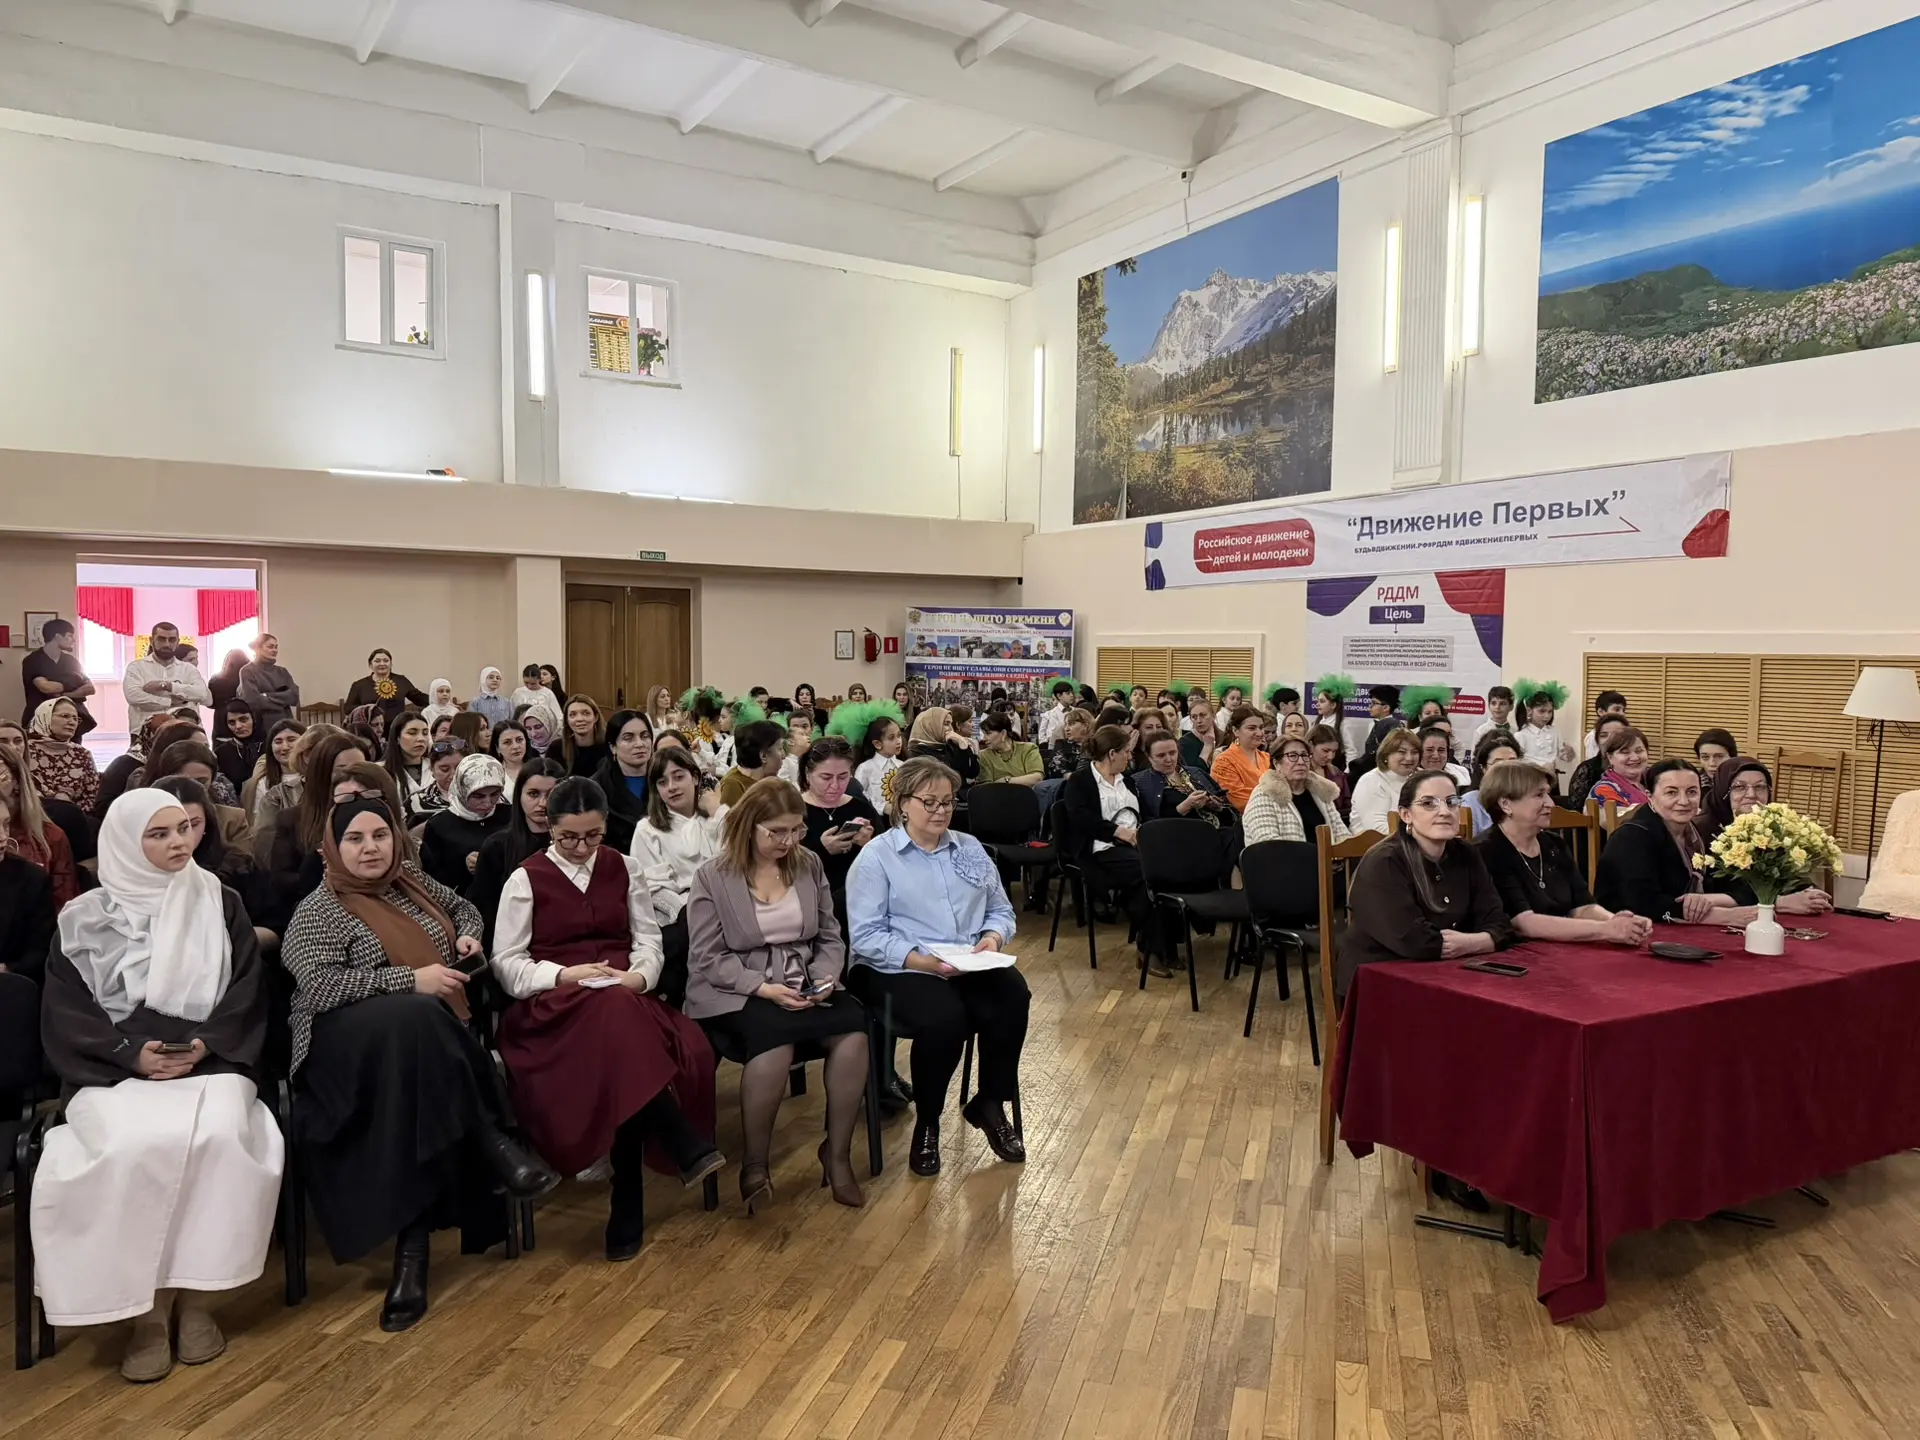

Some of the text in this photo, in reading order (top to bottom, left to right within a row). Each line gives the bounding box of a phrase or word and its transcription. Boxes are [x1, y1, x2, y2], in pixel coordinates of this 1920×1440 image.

[1198, 529, 1310, 549] Российское движение
[1213, 547, 1309, 567] детей и молодежи
[1377, 586, 1419, 603] РДДМ
[1005, 614, 1056, 625] ВРЕМЕНИ
[1384, 608, 1412, 621] Цель
